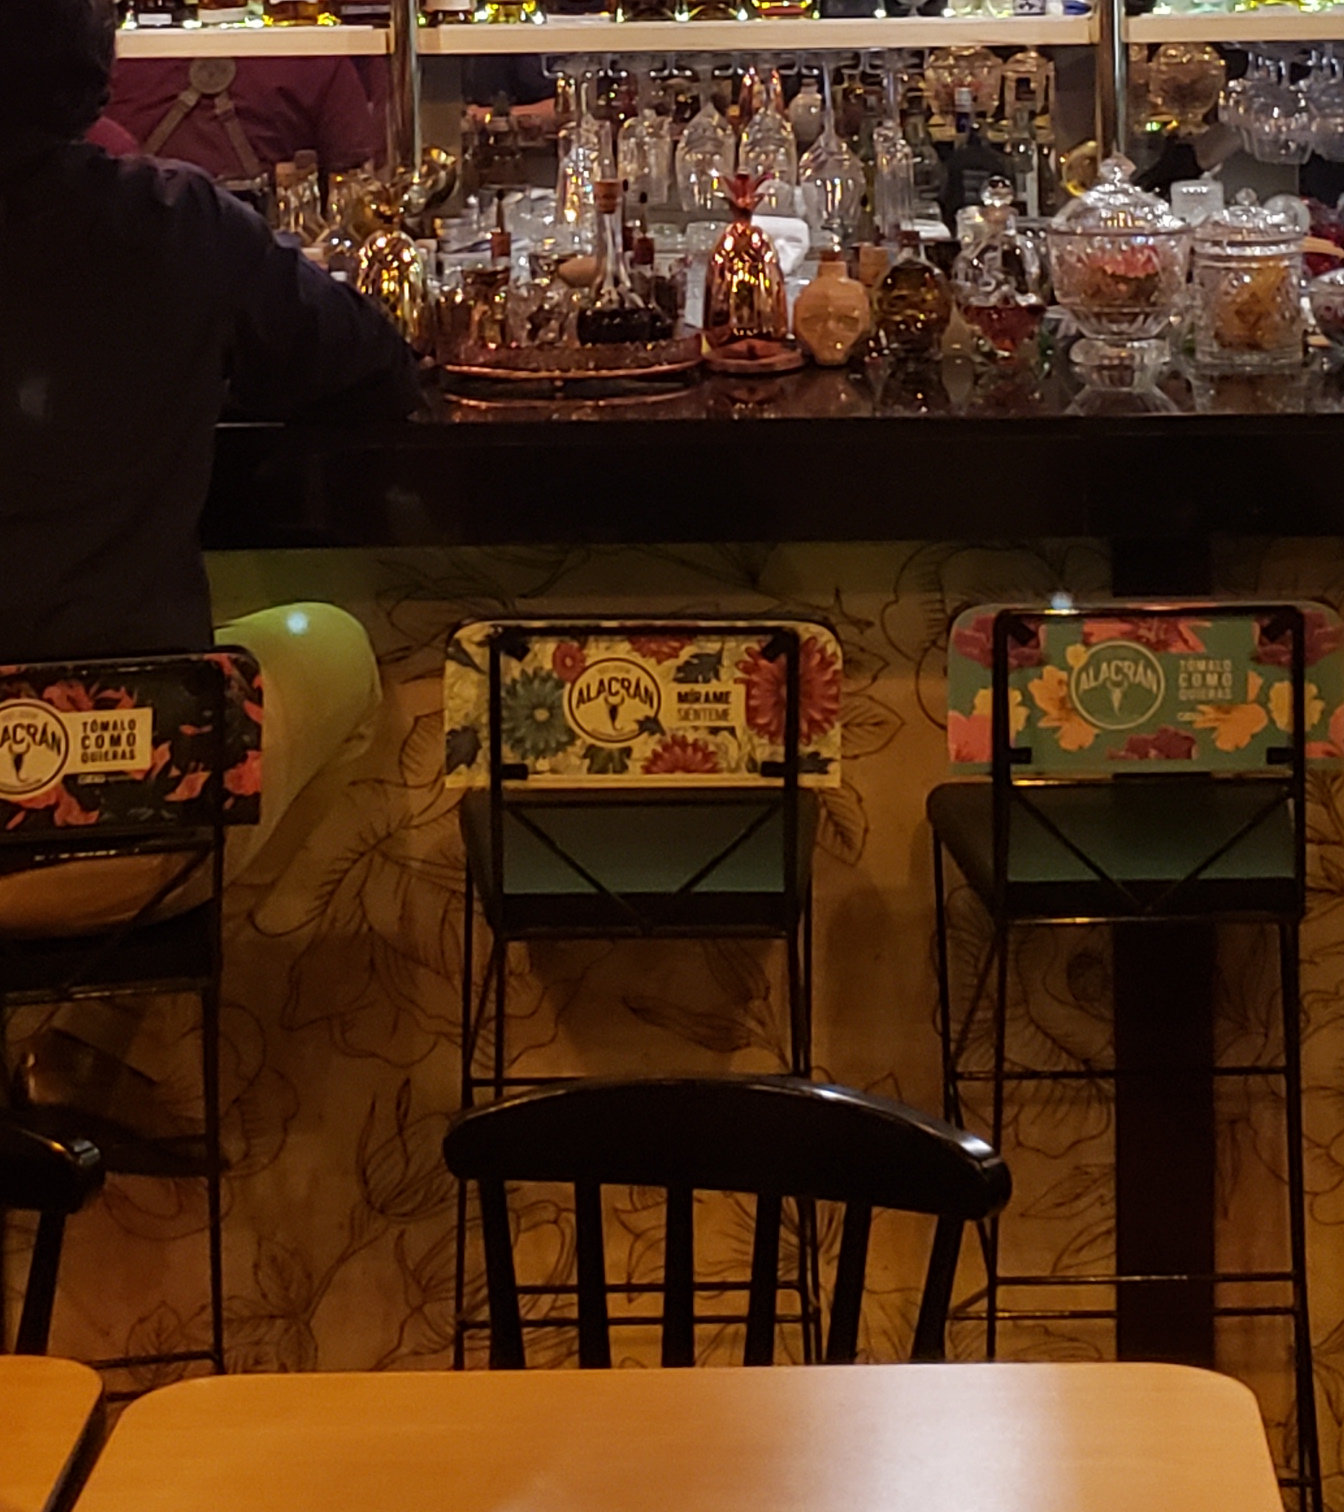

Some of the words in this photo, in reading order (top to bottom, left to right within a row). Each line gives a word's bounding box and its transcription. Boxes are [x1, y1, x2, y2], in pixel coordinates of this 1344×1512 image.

[1178, 672, 1233, 688] COMO
[575, 675, 655, 711] ALACRÁN
[80, 732, 137, 750] COMO
